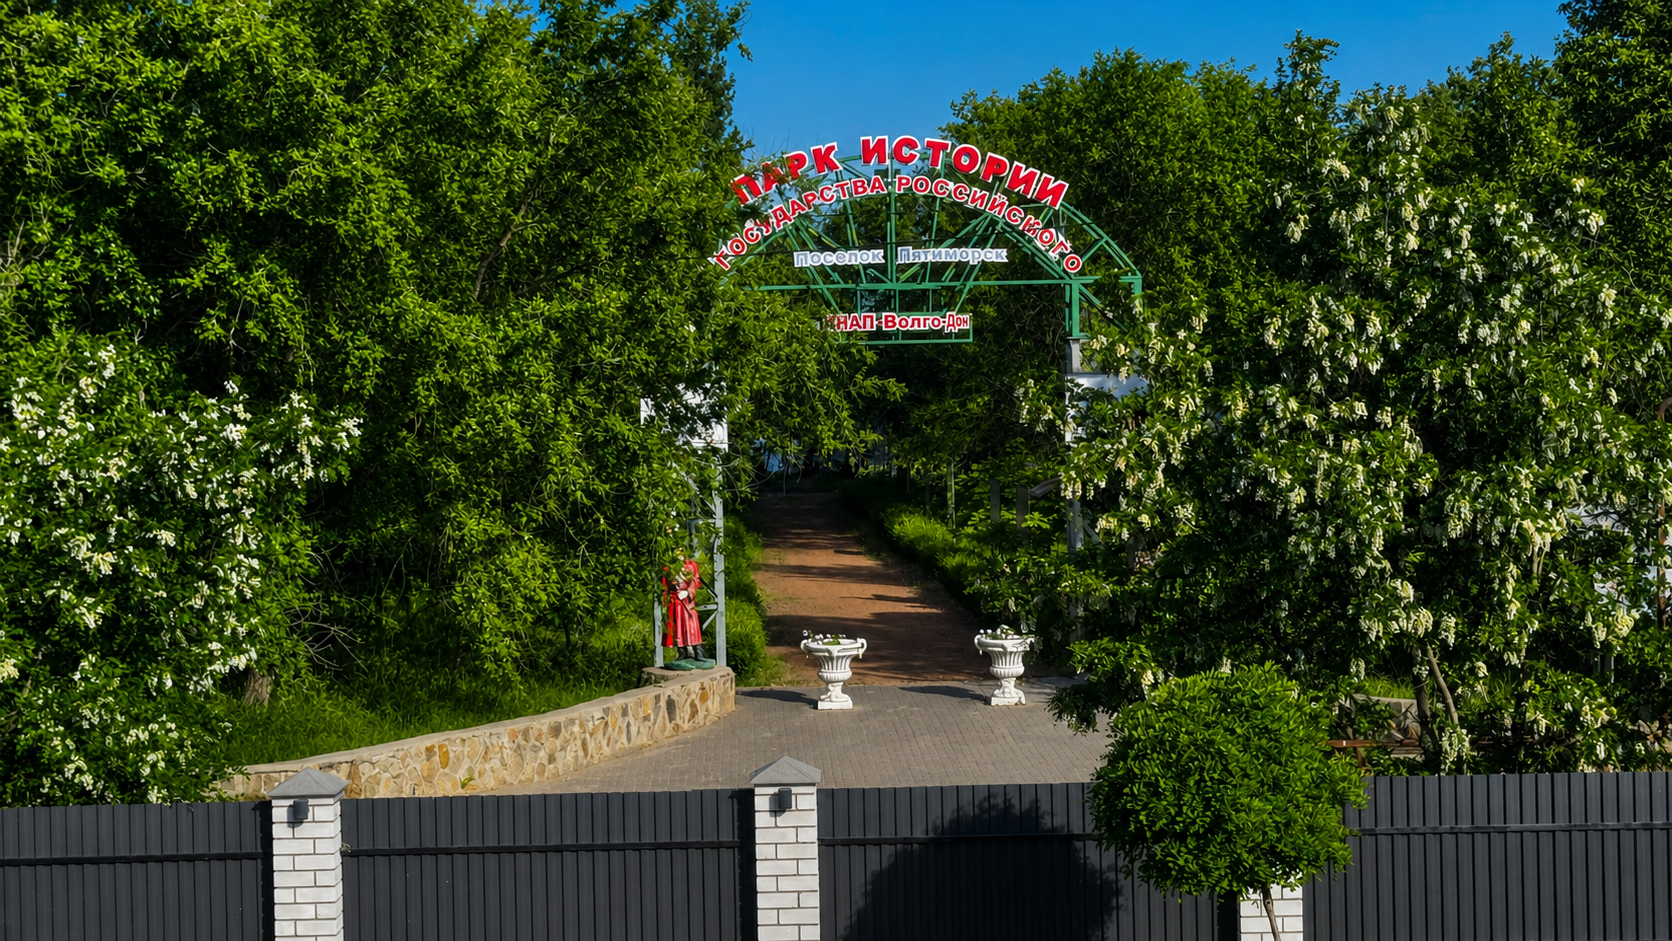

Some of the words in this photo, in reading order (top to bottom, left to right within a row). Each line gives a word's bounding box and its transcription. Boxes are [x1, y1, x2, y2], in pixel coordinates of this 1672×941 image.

[730, 142, 842, 206] ПАРК
[860, 135, 1069, 210] ИСТОРИИ
[711, 175, 888, 271] ГОСУДАРСТВА
[895, 174, 1082, 273] РОССИЙСКОГО
[793, 249, 885, 267] Поселок
[896, 246, 1008, 265] Пятиморск
